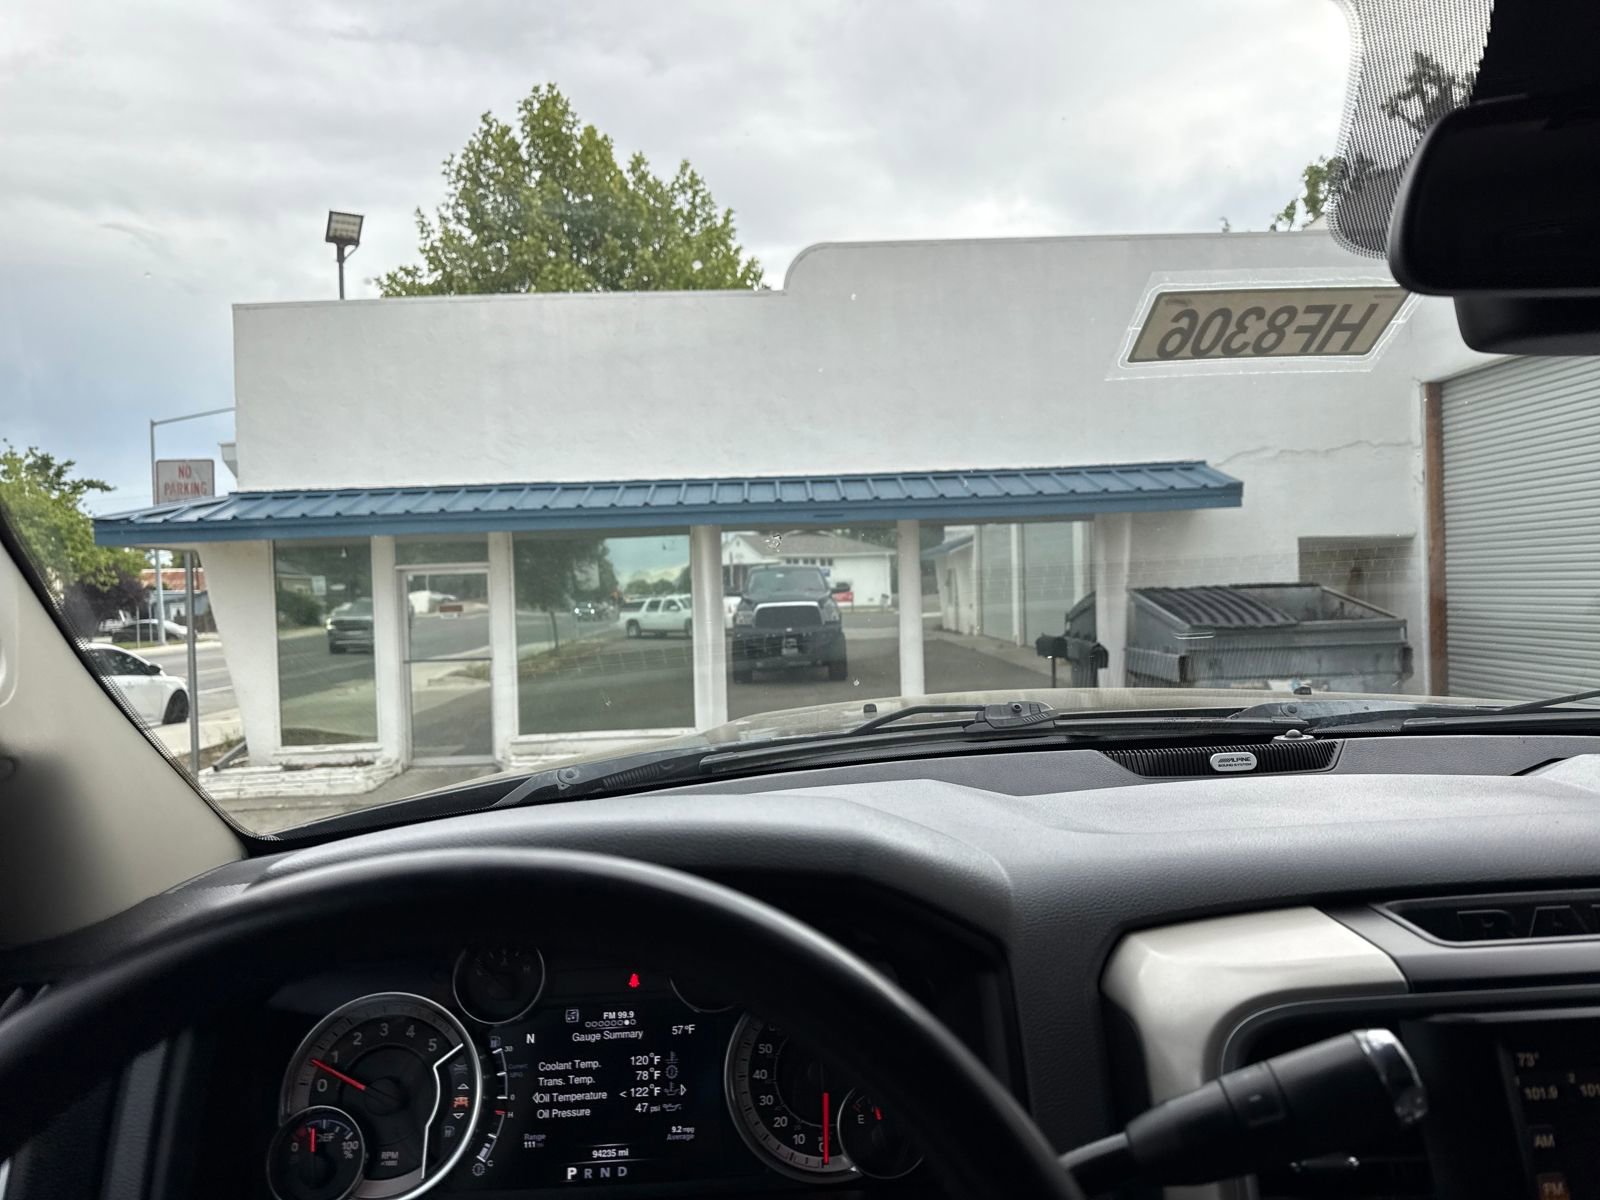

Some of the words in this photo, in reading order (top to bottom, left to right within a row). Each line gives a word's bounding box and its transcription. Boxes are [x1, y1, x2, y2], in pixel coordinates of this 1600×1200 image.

[178, 465, 193, 479] NO
[164, 481, 207, 496] PARKING
[603, 1012, 616, 1020] FM
[617, 1011, 635, 1019] 99.9
[380, 1023, 389, 1037] 3
[406, 1025, 415, 1038] 4
[572, 1032, 601, 1043] Gauge
[603, 1029, 644, 1041] Summary
[353, 1032, 363, 1045] 2
[428, 1038, 438, 1051] 5
[526, 1033, 535, 1044] N
[758, 1043, 773, 1054] 50
[332, 1052, 339, 1063] 1
[538, 1061, 572, 1072] Coolant
[574, 1060, 602, 1070] Temp.
[752, 1069, 768, 1080] 40
[316, 1078, 328, 1092] 0
[538, 1076, 566, 1087] Trans.
[568, 1075, 595, 1086] Temp.
[538, 1093, 549, 1103] Oil
[552, 1090, 607, 1103] Temperature
[759, 1094, 774, 1105] 30
[536, 1108, 549, 1119] Oil
[552, 1106, 591, 1118] Pressure
[635, 1103, 648, 1112] 47
[773, 1116, 788, 1128] 20
[858, 1114, 865, 1124] E
[793, 1133, 806, 1145] 10
[1535, 1133, 1555, 1148] AM
[291, 1142, 299, 1152] 0
[342, 1141, 358, 1150] 100
[381, 1151, 399, 1160] RPM
[592, 1149, 616, 1158] 94235
[618, 1147, 629, 1156] mi
[567, 1168, 577, 1180] P
[584, 1169, 593, 1179] R
[600, 1167, 610, 1178] N
[617, 1166, 628, 1177] D
[1542, 1182, 1564, 1196] FM
